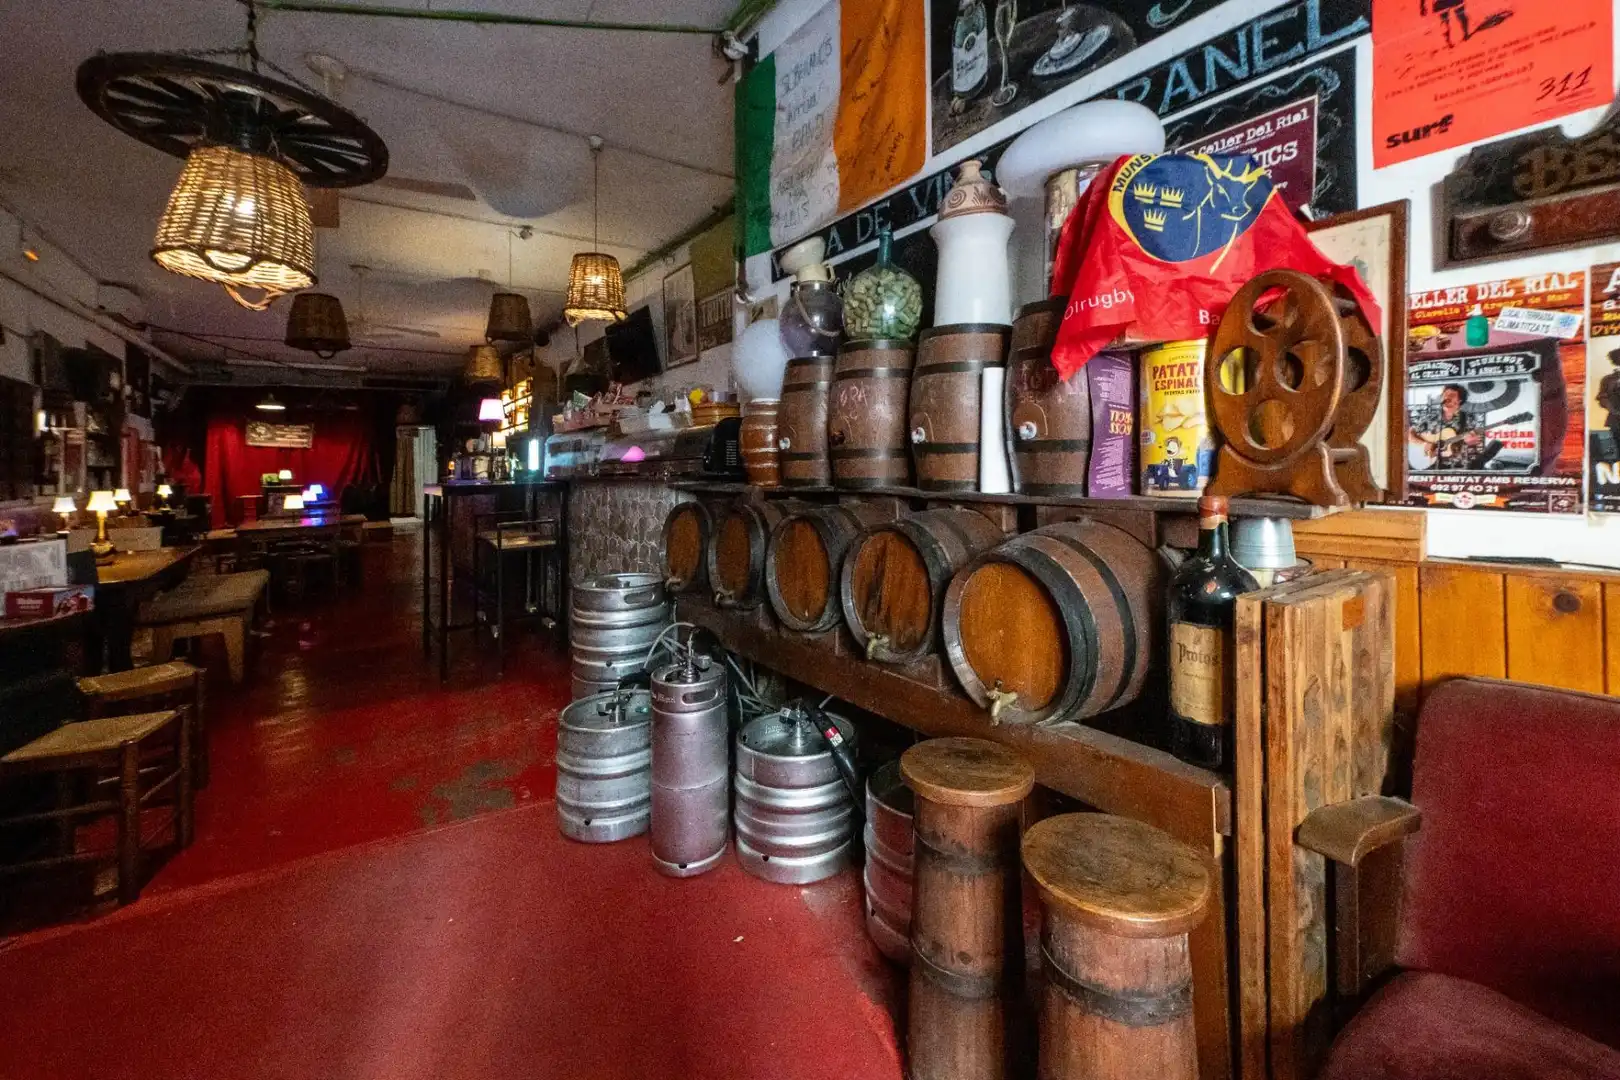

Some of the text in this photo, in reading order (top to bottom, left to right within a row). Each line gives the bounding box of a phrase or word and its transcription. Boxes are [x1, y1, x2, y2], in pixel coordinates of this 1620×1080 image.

[1536, 64, 1593, 102] 311
[1245, 120, 1274, 141] Del
[1275, 108, 1310, 131] Rial
[1386, 113, 1454, 149] surf
[1113, 154, 1154, 192] MUNS
[856, 200, 892, 243] DE
[1409, 271, 1578, 310] ELLER DEL RIAL
[1437, 475, 1481, 483] LIMITAT
[1484, 476, 1511, 484] AMB
[1513, 477, 1577, 485] RESERVA
[1176, 642, 1220, 667] Protos
